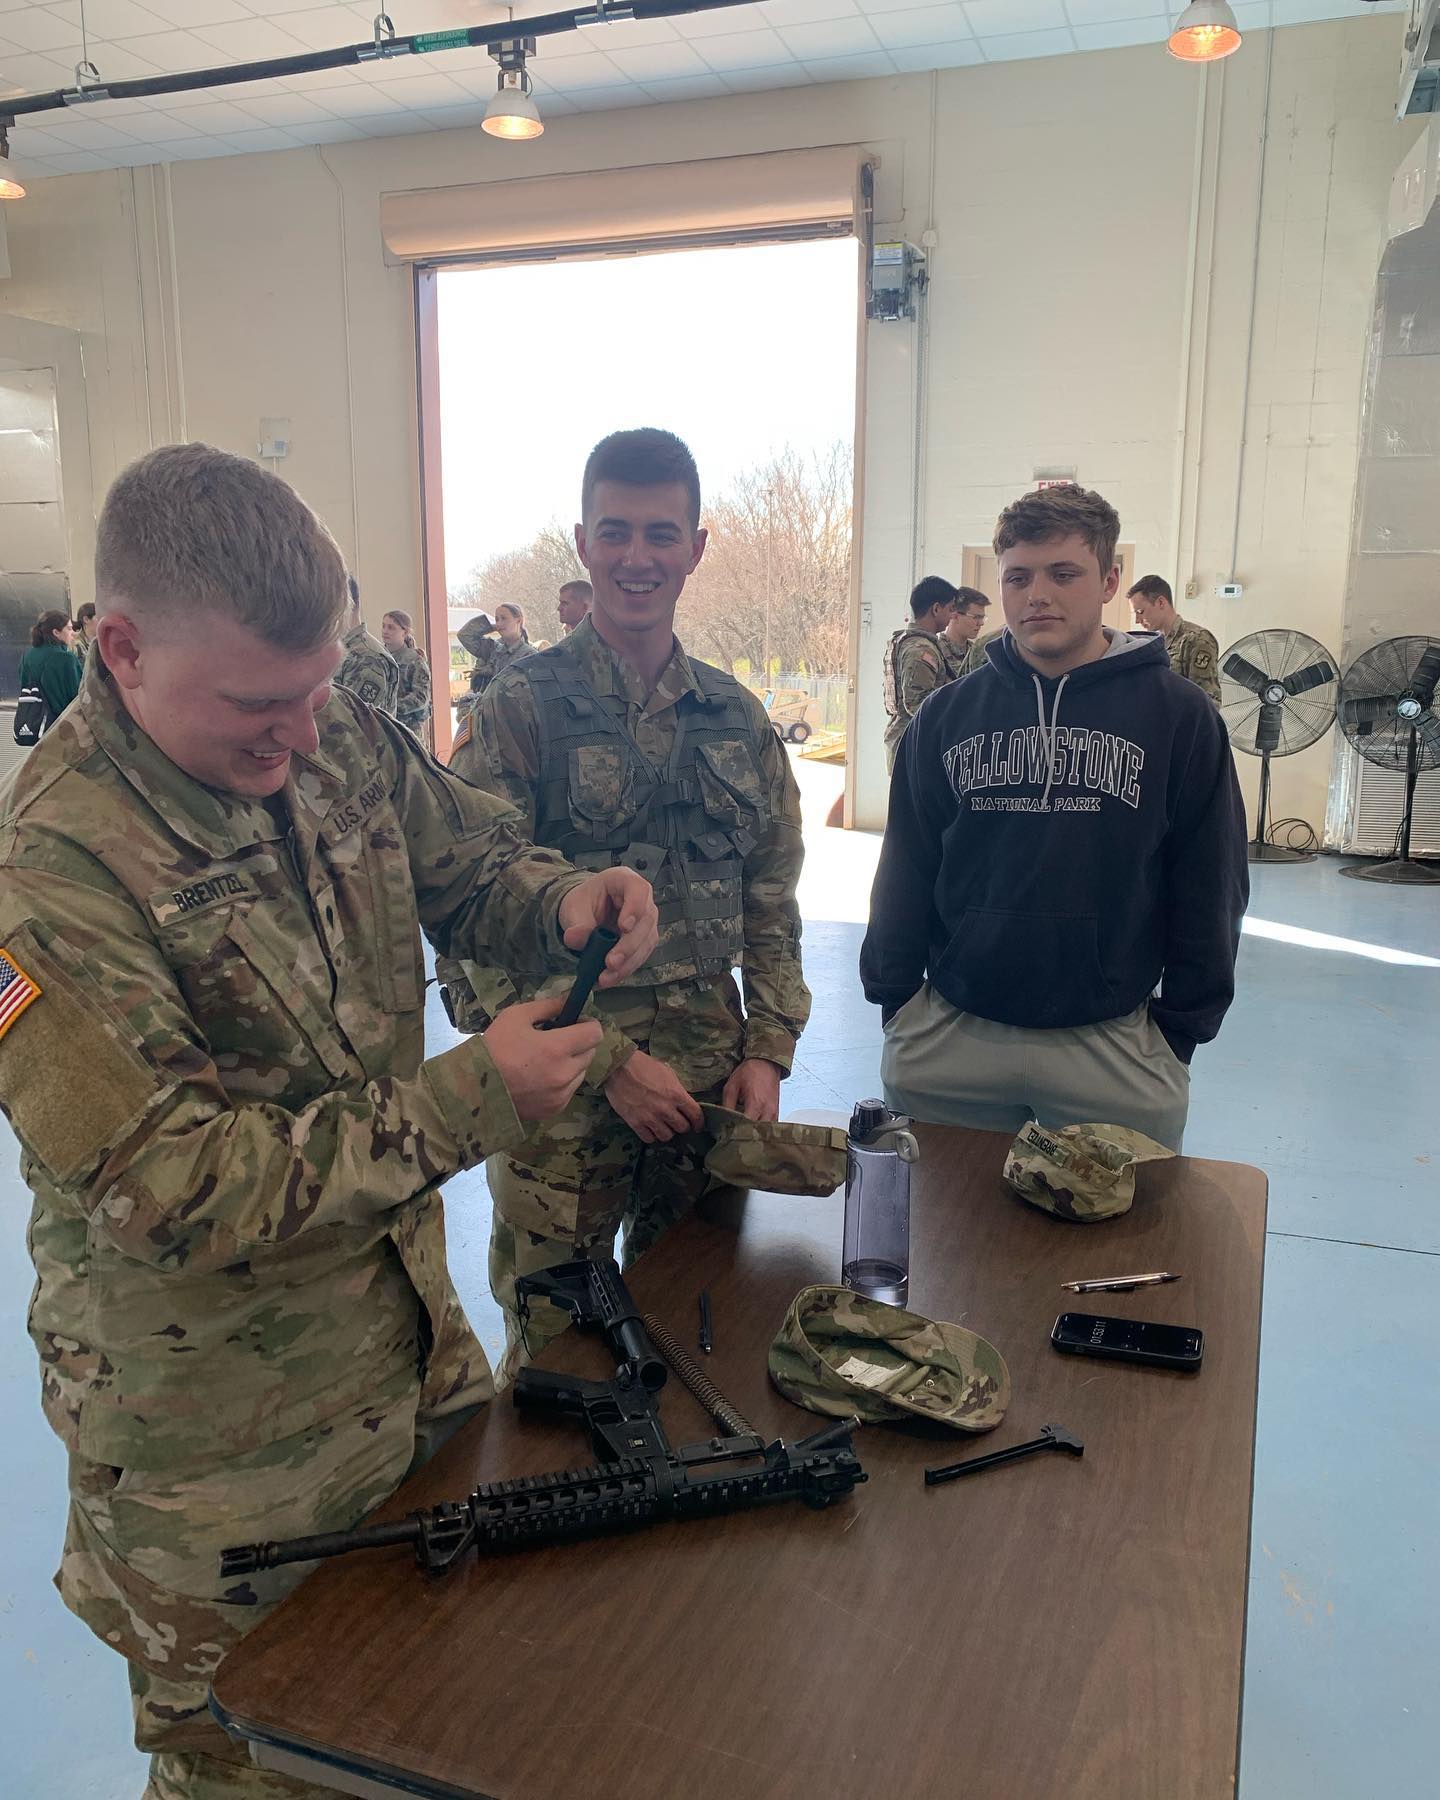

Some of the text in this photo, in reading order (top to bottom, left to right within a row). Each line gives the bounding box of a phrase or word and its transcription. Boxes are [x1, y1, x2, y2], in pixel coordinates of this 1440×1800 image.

[943, 726, 1145, 808] YELLOWSTONE
[971, 797, 1101, 812] NATIONAL PARK
[172, 873, 249, 912] BRENTZEL
